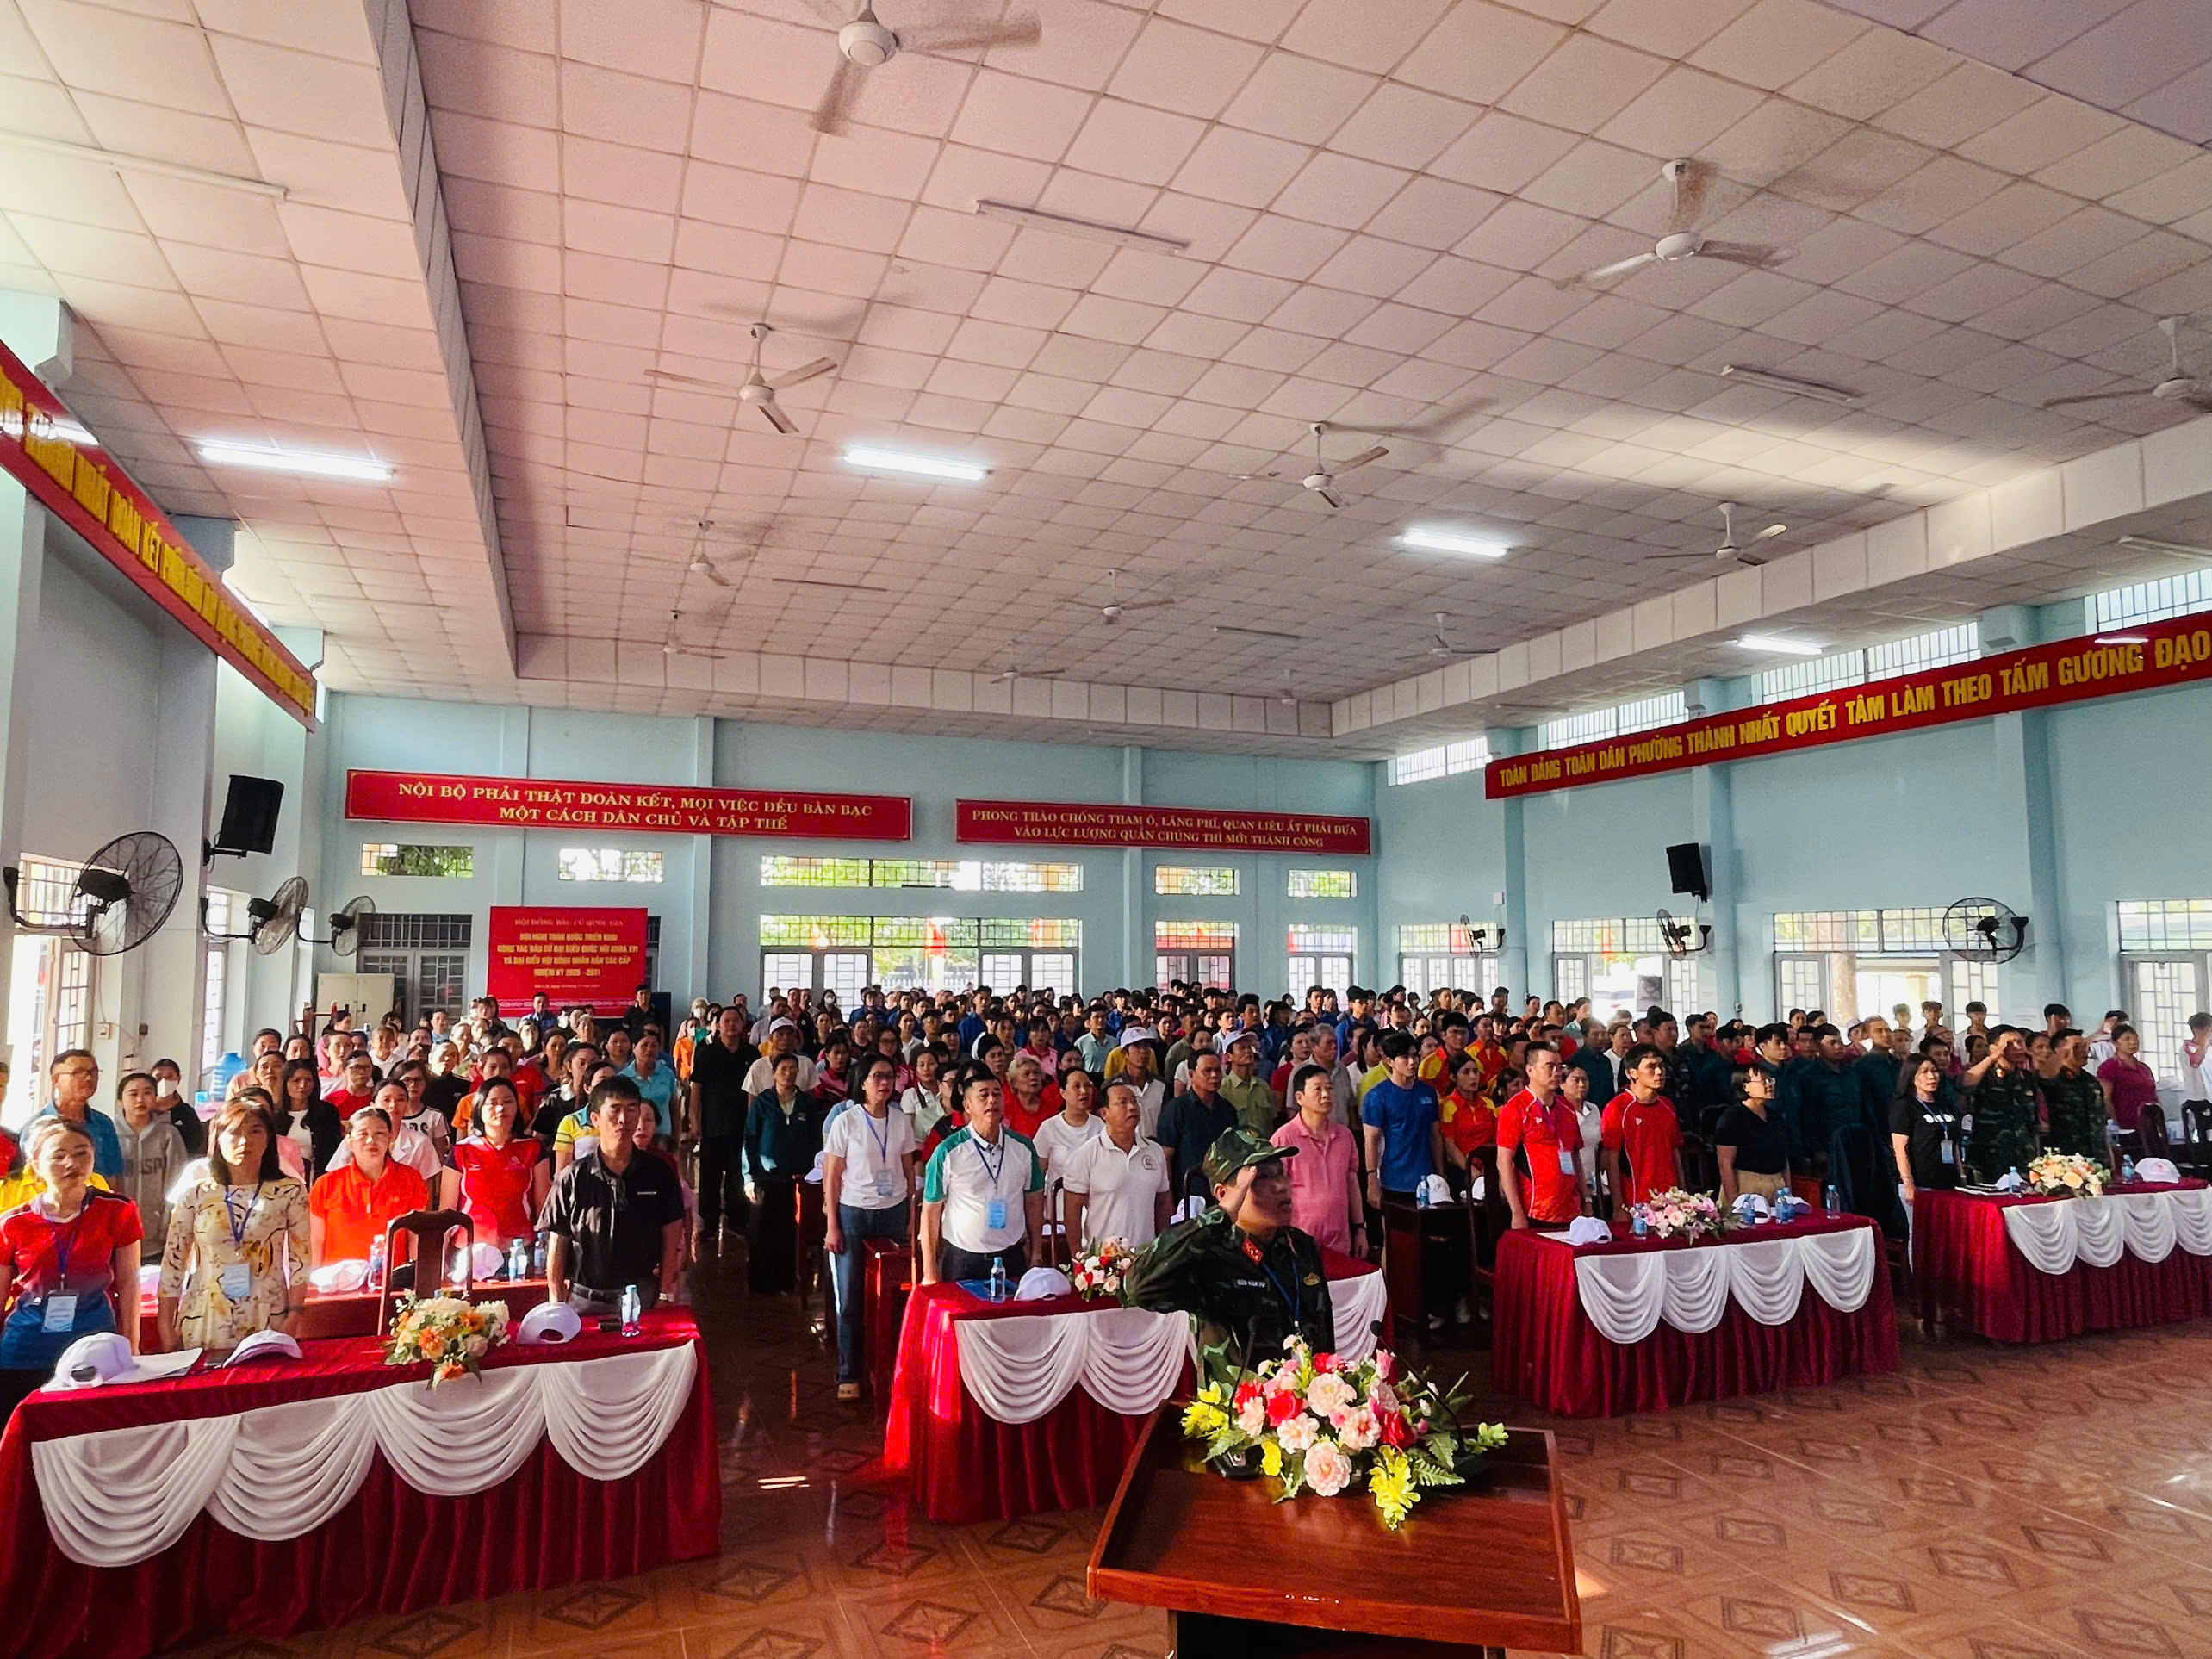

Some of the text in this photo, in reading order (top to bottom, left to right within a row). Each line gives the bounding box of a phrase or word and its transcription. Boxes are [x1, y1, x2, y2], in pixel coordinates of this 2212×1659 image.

[1500, 764, 1526, 787] TOÀN
[1565, 750, 1596, 775] TOÀN
[1599, 745, 1625, 770] DÂN
[1629, 735, 1683, 765] PHƯỜNG
[1687, 724, 1735, 755] THÀNH
[1739, 710, 1780, 744] NHẤT
[1786, 699, 1836, 737] QUYẾT
[1845, 693, 1885, 724] TÂM
[1892, 684, 1935, 717] LÀM
[1942, 674, 1992, 707] THEO
[1999, 657, 2049, 696] TẤM
[2057, 643, 2144, 686] GƯƠNG
[2154, 630, 2211, 671] ĐẠO
[399, 781, 434, 798] NỘI
[441, 784, 466, 800] BỘ
[473, 785, 520, 801] PHẢI
[525, 788, 575, 805] THẬT
[680, 798, 713, 811] MỌI
[719, 798, 758, 813] VIỆC
[804, 800, 836, 815] BÀN
[841, 805, 872, 818] BẠC
[500, 805, 788, 830] MỘT CÁCH DÂN CHỦ VÀ TẬP THỂ
[972, 810, 1018, 821] PHONG
[1022, 811, 1057, 822] TRÀO
[1060, 810, 1103, 823] CHỐNG
[1109, 814, 1142, 825] THAM
[1162, 816, 1193, 828] LÃNG
[1223, 819, 1254, 830] QUAN
[1258, 819, 1283, 832] LIÊU
[1014, 824, 1041, 837] VÀO
[1045, 826, 1071, 839] LỰC
[1073, 826, 1116, 840] LƯỢNG
[1252, 833, 1289, 846] THÀNH
[1293, 834, 1323, 847] CÔNG
